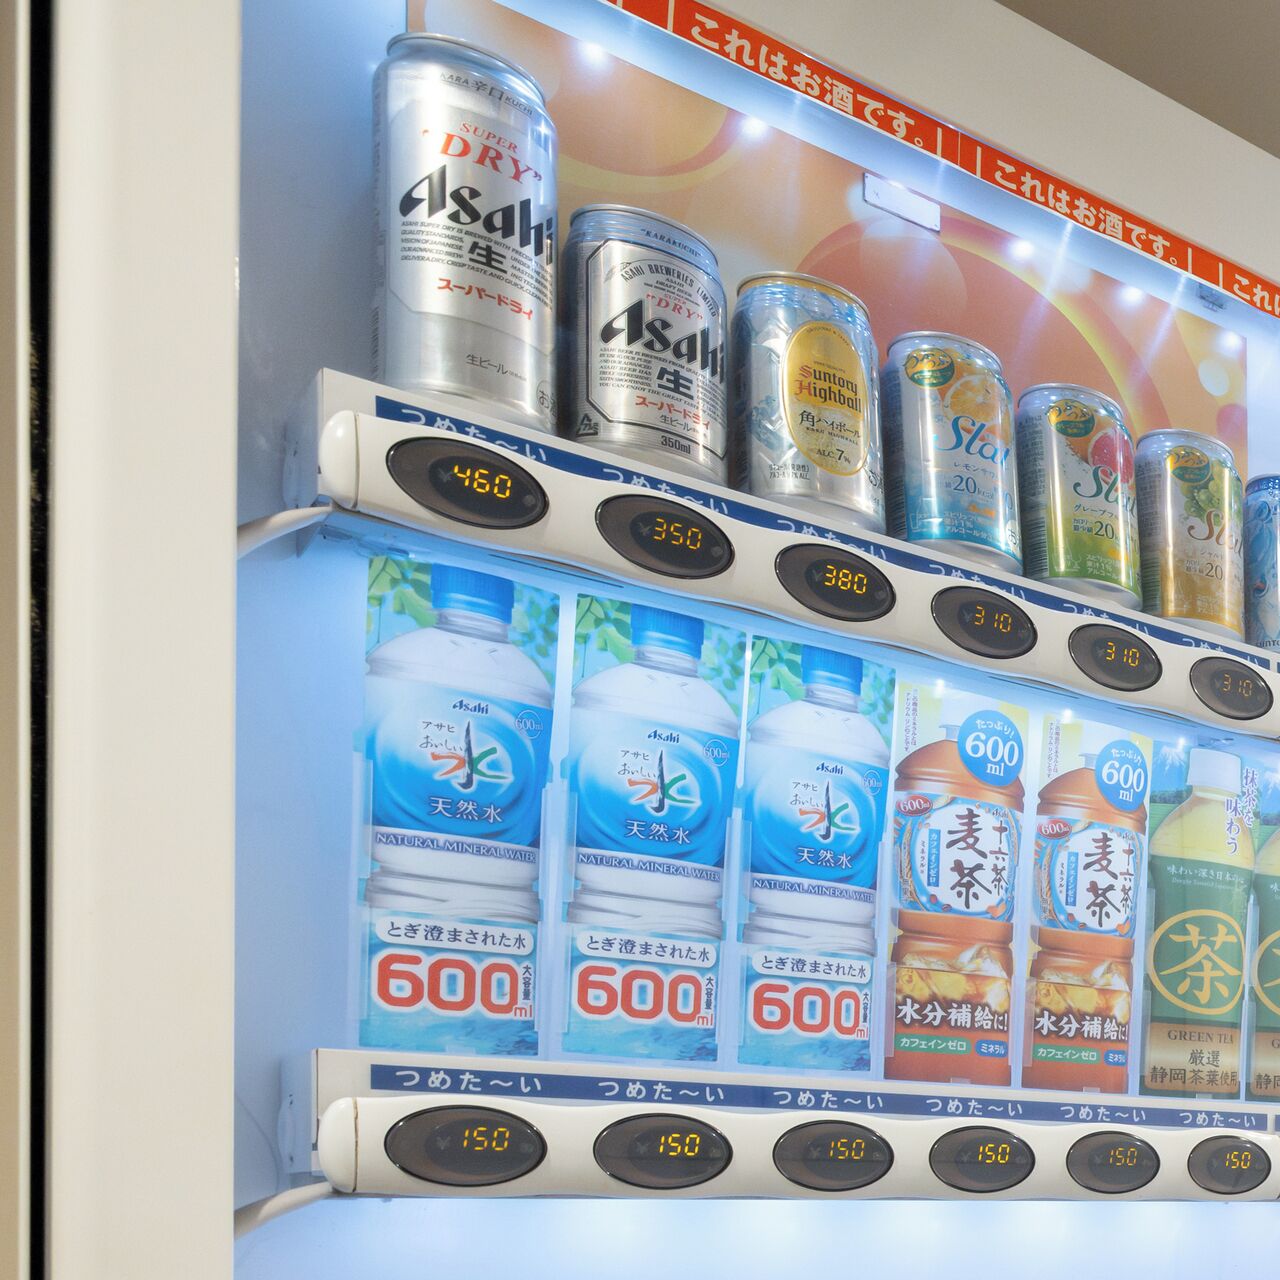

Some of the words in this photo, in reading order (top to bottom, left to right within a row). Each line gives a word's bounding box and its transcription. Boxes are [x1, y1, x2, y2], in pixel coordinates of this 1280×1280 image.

[691, 12, 924, 148] これはお酒です。
[459, 122, 519, 154] SUPER
[399, 164, 553, 266] Asahi
[994, 160, 1178, 266] これはお酒です。
[467, 240, 508, 275] 生
[620, 266, 645, 283] ASAHI
[649, 263, 695, 289] BREWERIES
[437, 277, 534, 321] スーパードライ
[599, 298, 725, 384] Asahi
[466, 353, 508, 376] 生ビール
[655, 366, 695, 401] 生
[799, 364, 859, 396] Suntory
[795, 378, 863, 414] Highball
[635, 394, 712, 430] スーパードライ
[799, 409, 862, 438] 角ハイボール
[660, 435, 692, 455] 350ml
[453, 463, 513, 500] 460
[653, 517, 704, 551] 350
[824, 564, 868, 595] 380
[974, 605, 1013, 634] 310
[1106, 641, 1141, 668] 310
[452, 698, 489, 715] Asahi
[422, 721, 455, 735] アサヒ
[647, 729, 681, 745] Asahi
[620, 749, 650, 762] アサヒ
[966, 732, 1020, 769] 600
[816, 762, 844, 777] Asahi
[986, 762, 1005, 778] ml
[1101, 768, 1146, 794] 600
[792, 781, 819, 792] アサヒ
[429, 796, 503, 824] 天然水
[625, 819, 692, 846] 天然水
[1224, 798, 1242, 856] 味わう
[376, 832, 441, 851] NATURAL
[445, 841, 503, 860] MINERAL
[798, 846, 853, 870] 天然水
[945, 807, 993, 910] 麦茶
[989, 820, 1009, 897] 十六茶
[578, 853, 635, 870] NATURAL
[638, 859, 691, 877] MINERAL
[1083, 832, 1122, 928] 麦茶
[387, 921, 526, 951] とぎ澄まされた水
[586, 935, 711, 963] とぎ澄まされた水
[761, 956, 867, 979] とぎ澄まされた水
[1159, 923, 1243, 1005] 茶
[900, 1037, 967, 1052] カフェインゼロ
[1167, 1029, 1214, 1044] GREEN
[1217, 1032, 1235, 1045] TEA
[1038, 1048, 1097, 1061] カフェインゼロ
[1188, 1048, 1222, 1069] 厳選
[1149, 1064, 1239, 1088] 静岡茶葉使用
[462, 1127, 511, 1152] 150
[659, 1133, 702, 1157] 150
[828, 1138, 865, 1160] 150
[978, 1144, 1011, 1165] 150
[1225, 1151, 1252, 1170] 150
